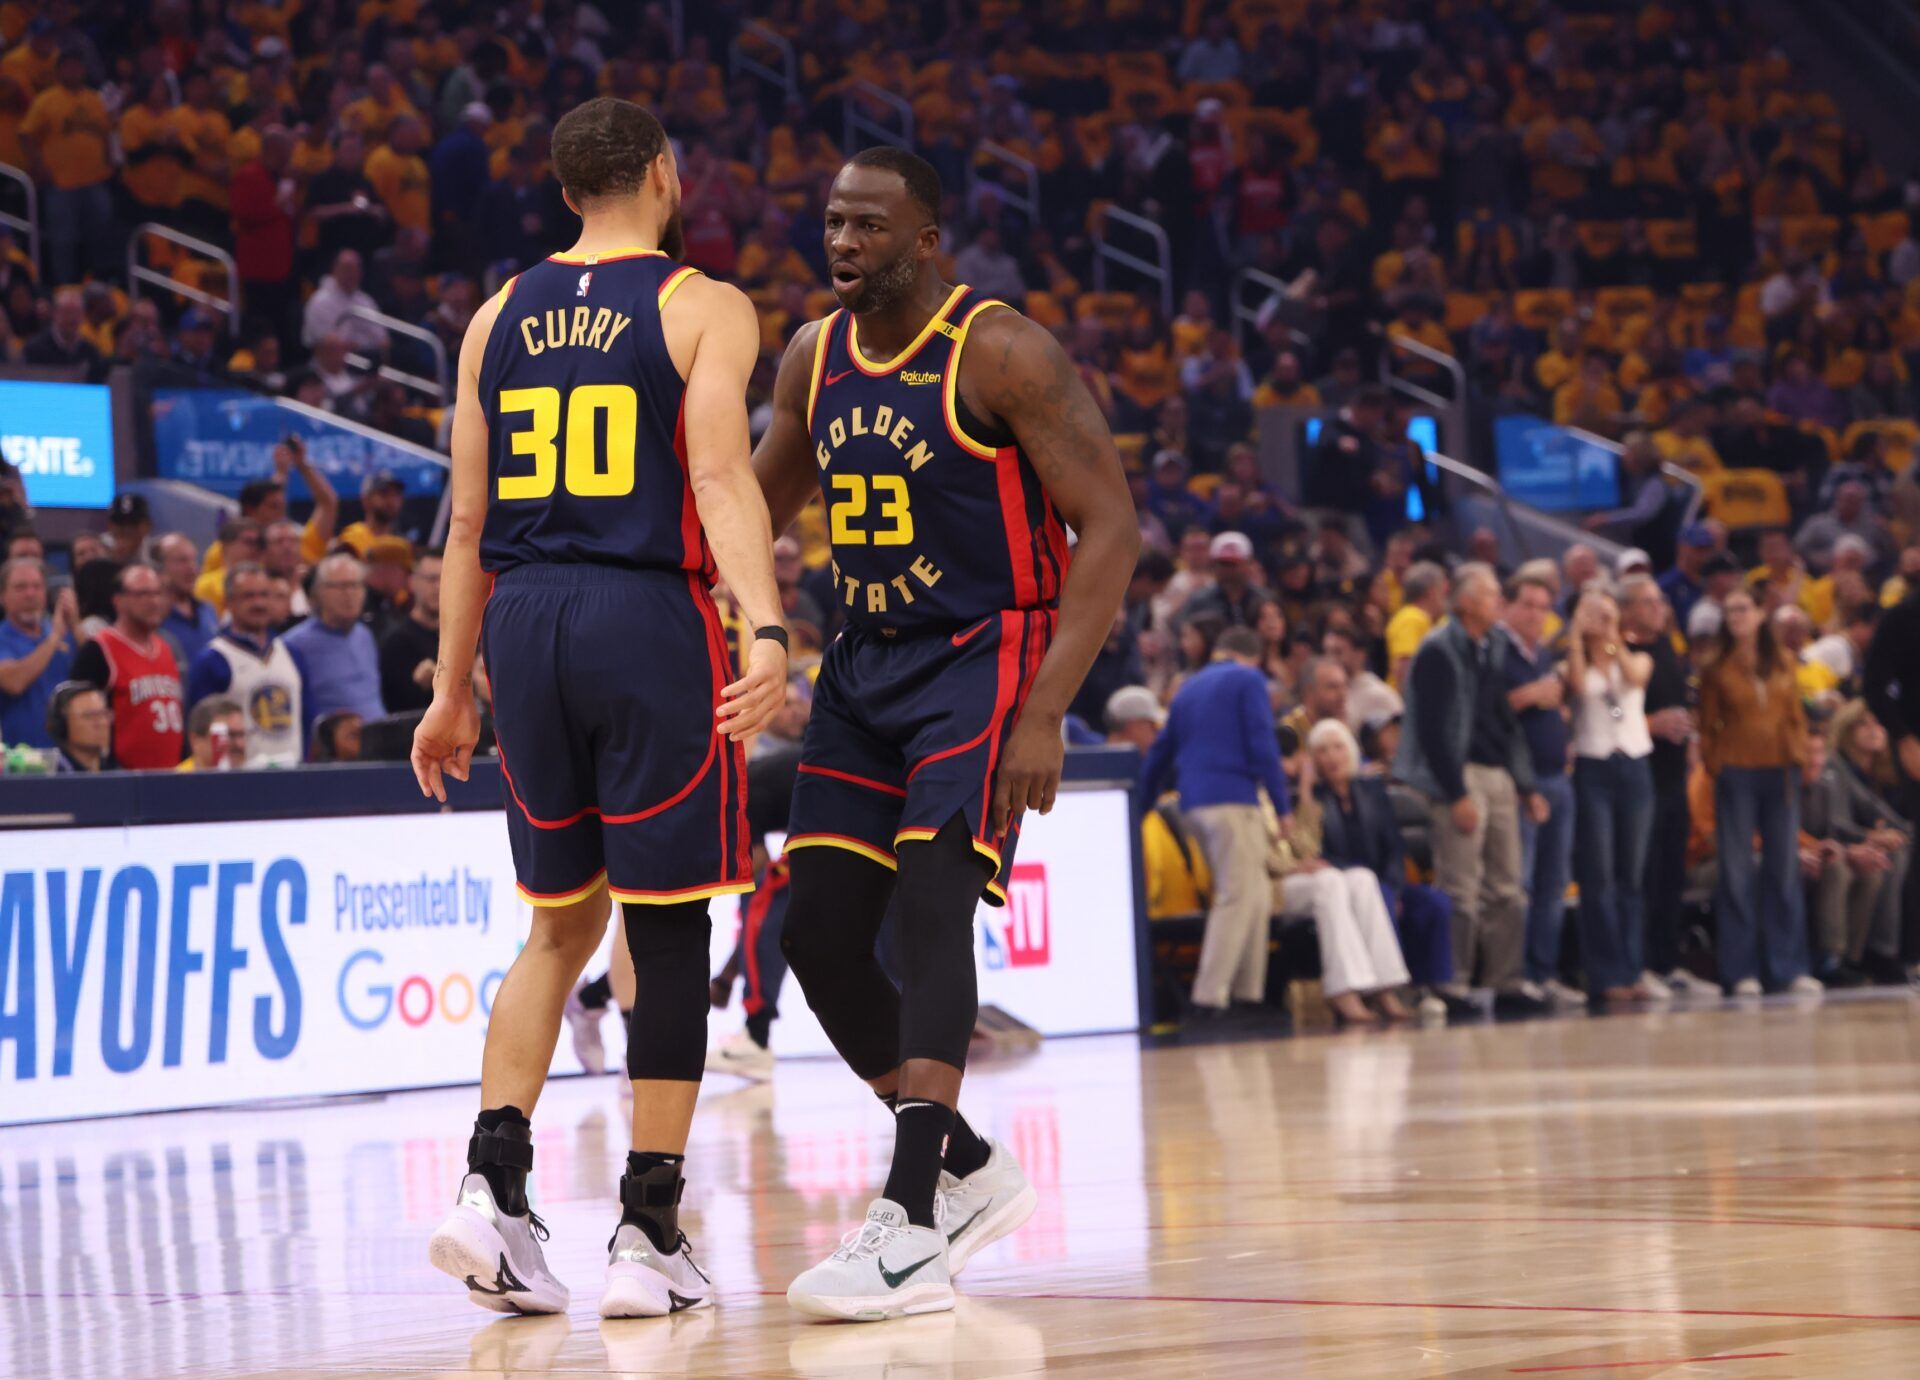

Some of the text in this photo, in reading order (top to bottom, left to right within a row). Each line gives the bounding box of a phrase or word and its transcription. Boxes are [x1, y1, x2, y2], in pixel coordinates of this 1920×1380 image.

[520, 306, 631, 356] CURRY
[900, 370, 941, 384] Rakuten
[498, 384, 637, 499] 30
[816, 405, 934, 472] GOLDEN
[831, 474, 914, 545] 23
[335, 867, 491, 934] Presented by
